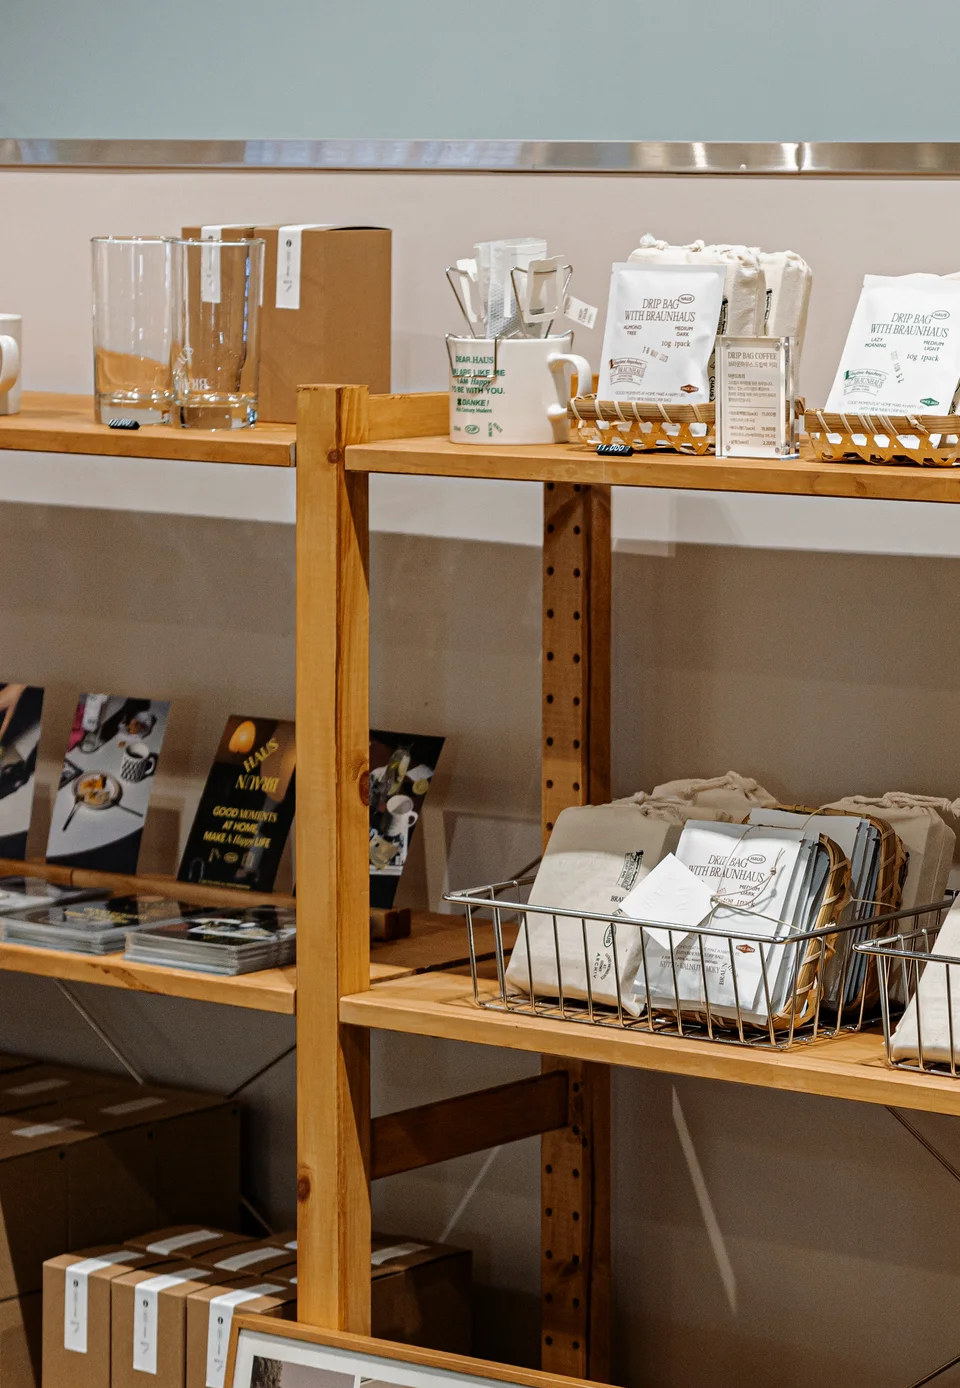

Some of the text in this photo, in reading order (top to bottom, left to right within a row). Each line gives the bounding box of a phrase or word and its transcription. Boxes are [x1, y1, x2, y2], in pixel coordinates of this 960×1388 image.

[642, 298, 679, 310] DRIP BAG
[624, 310, 696, 322] WITH BRAUNHAUS
[891, 312, 932, 325] DRIP BAG
[870, 324, 893, 334] WITH
[893, 325, 950, 338] BRAUNHAUS
[661, 340, 691, 348] 10g 1pack
[472, 356, 494, 364] HAUS
[728, 351, 777, 360] DRIP BAG COFFEE
[470, 378, 491, 388] Happy
[486, 387, 505, 395] YOU.
[243, 737, 280, 773] HAUS
[235, 774, 280, 793] BRAUN
[212, 805, 279, 824] GOOD MOMENTS
[222, 820, 233, 830] AT
[203, 831, 226, 844] MAKE
[232, 835, 254, 848] Happy
[254, 838, 272, 849] LIFE
[730, 856, 748, 869] BAG
[709, 866, 766, 883] BRAUNHAUS
[592, 952, 601, 979] ARCHIV
